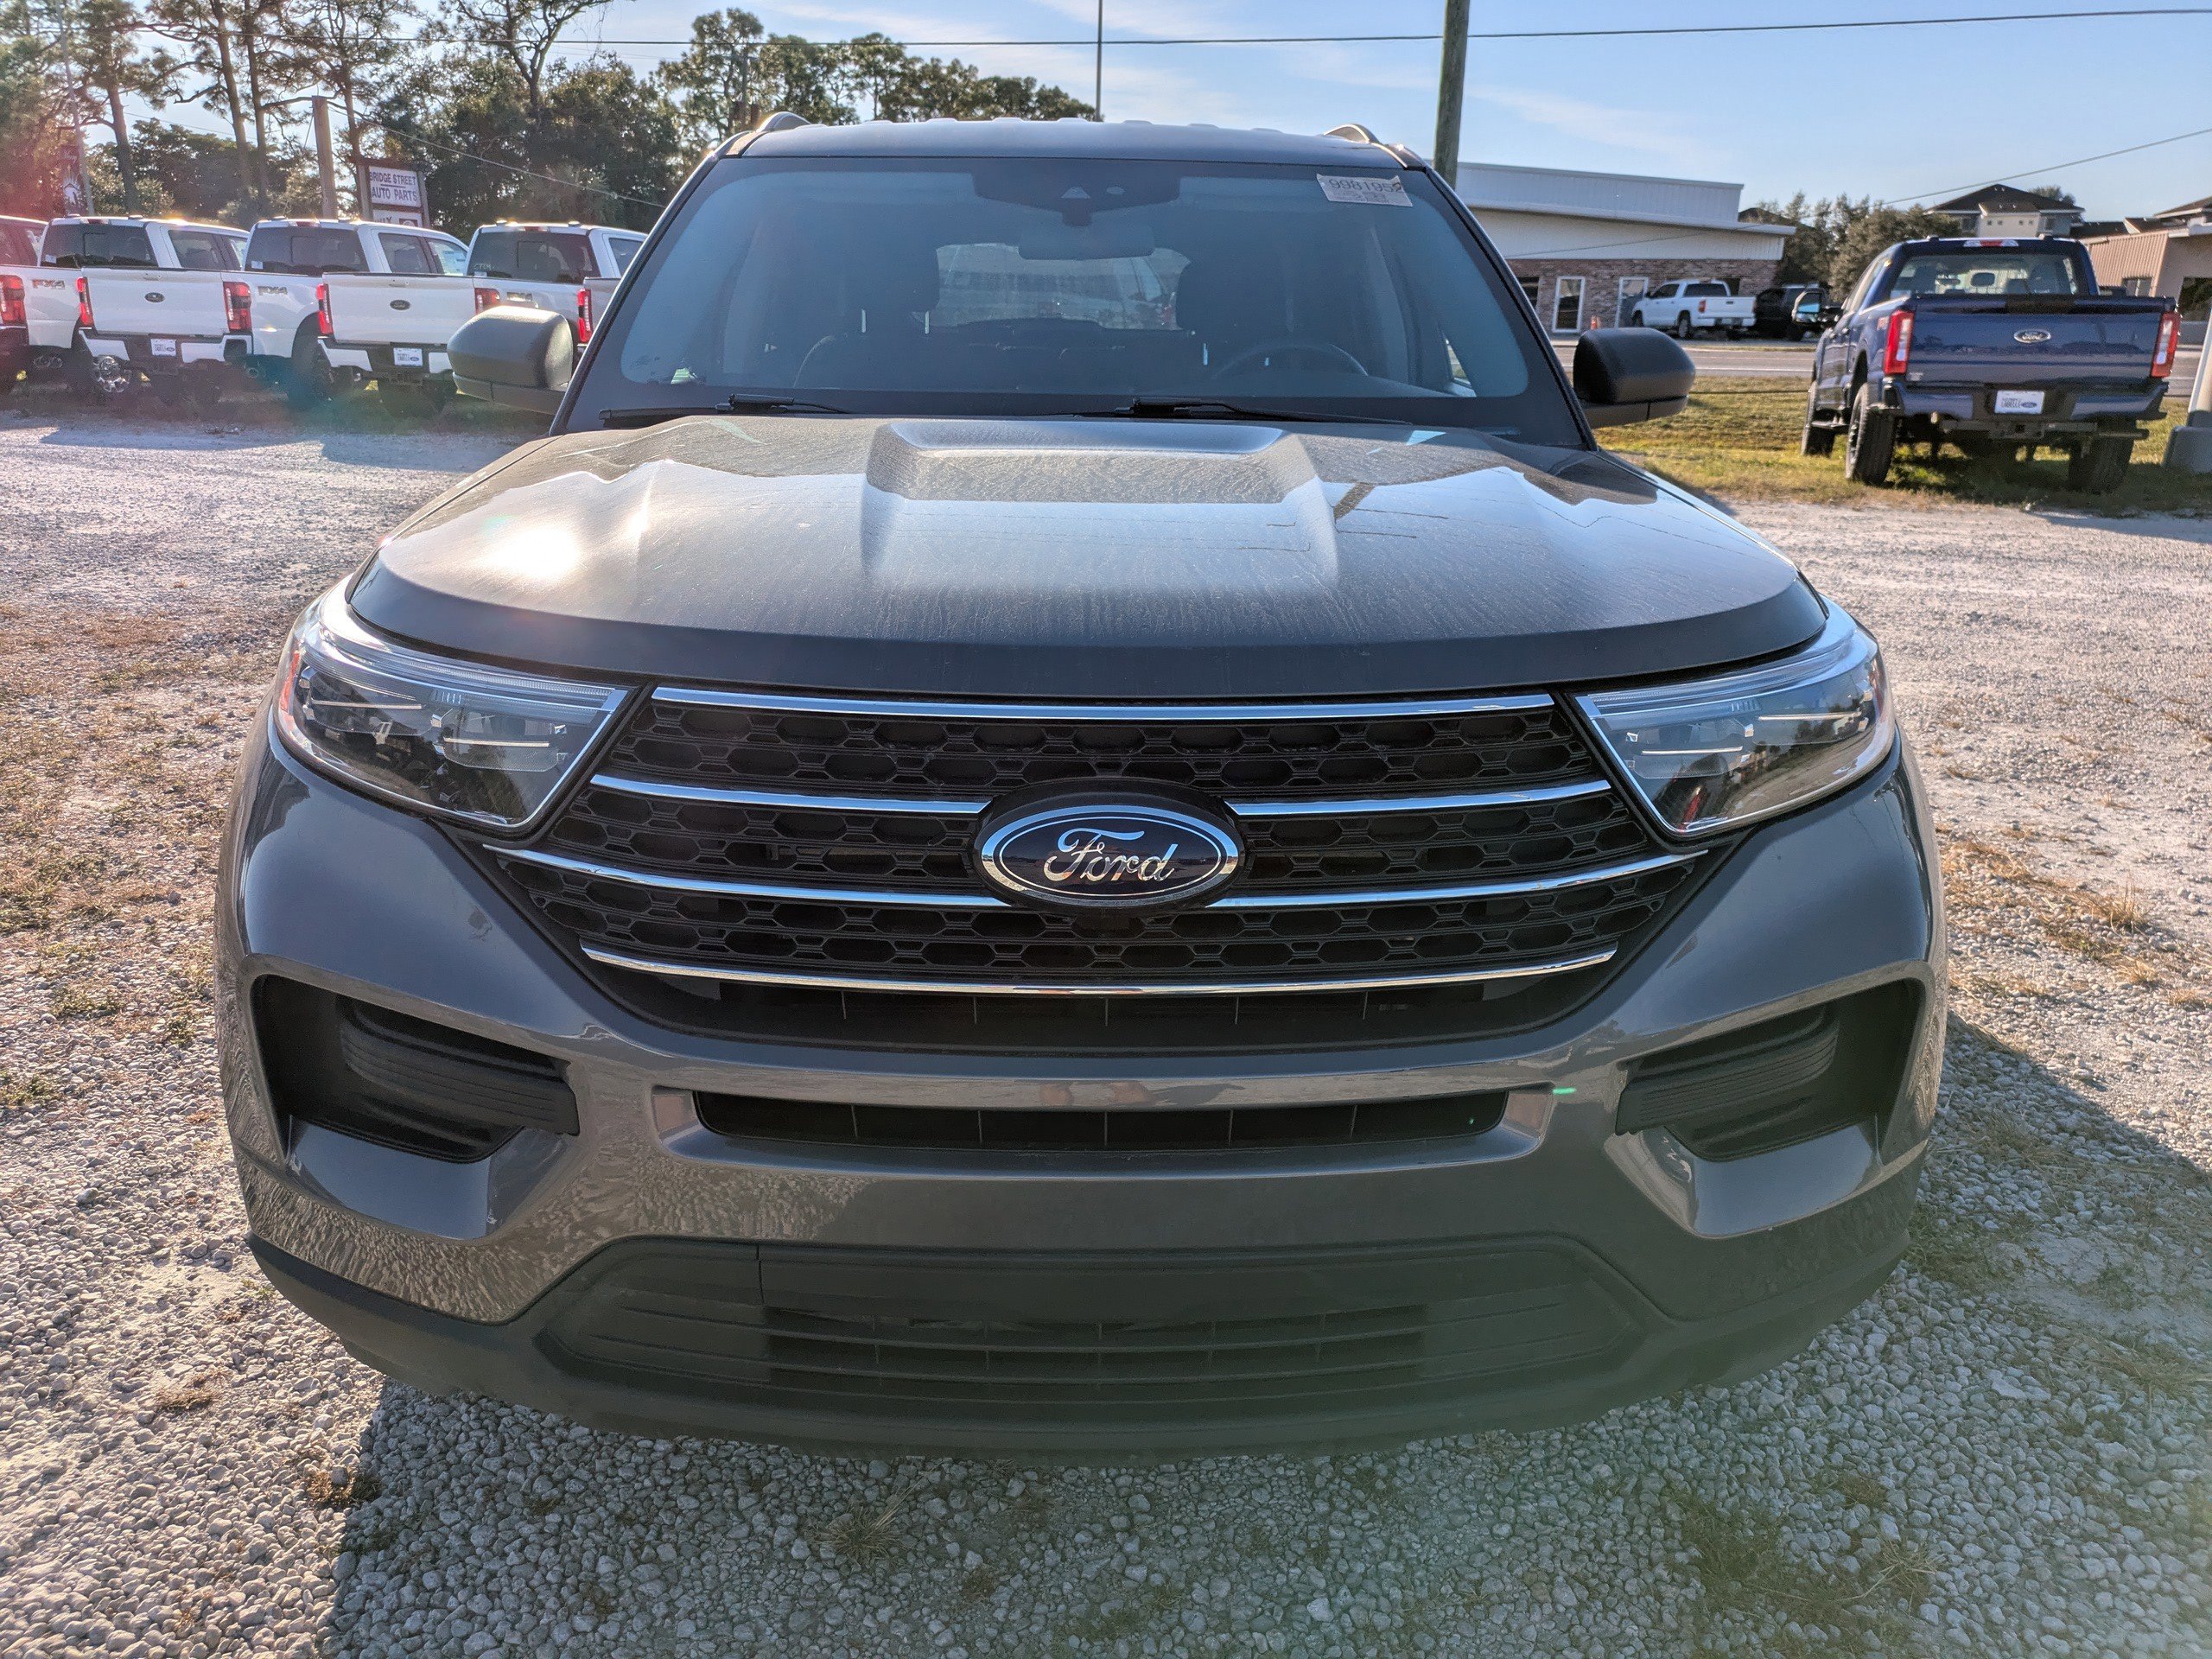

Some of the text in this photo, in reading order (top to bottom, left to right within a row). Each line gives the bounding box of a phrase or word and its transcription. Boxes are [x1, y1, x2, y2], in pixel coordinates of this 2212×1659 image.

[370, 172, 416, 186] BRIDGE STREET
[372, 187, 418, 202] AUTO PARTS
[1043, 827, 1179, 882] Ford
